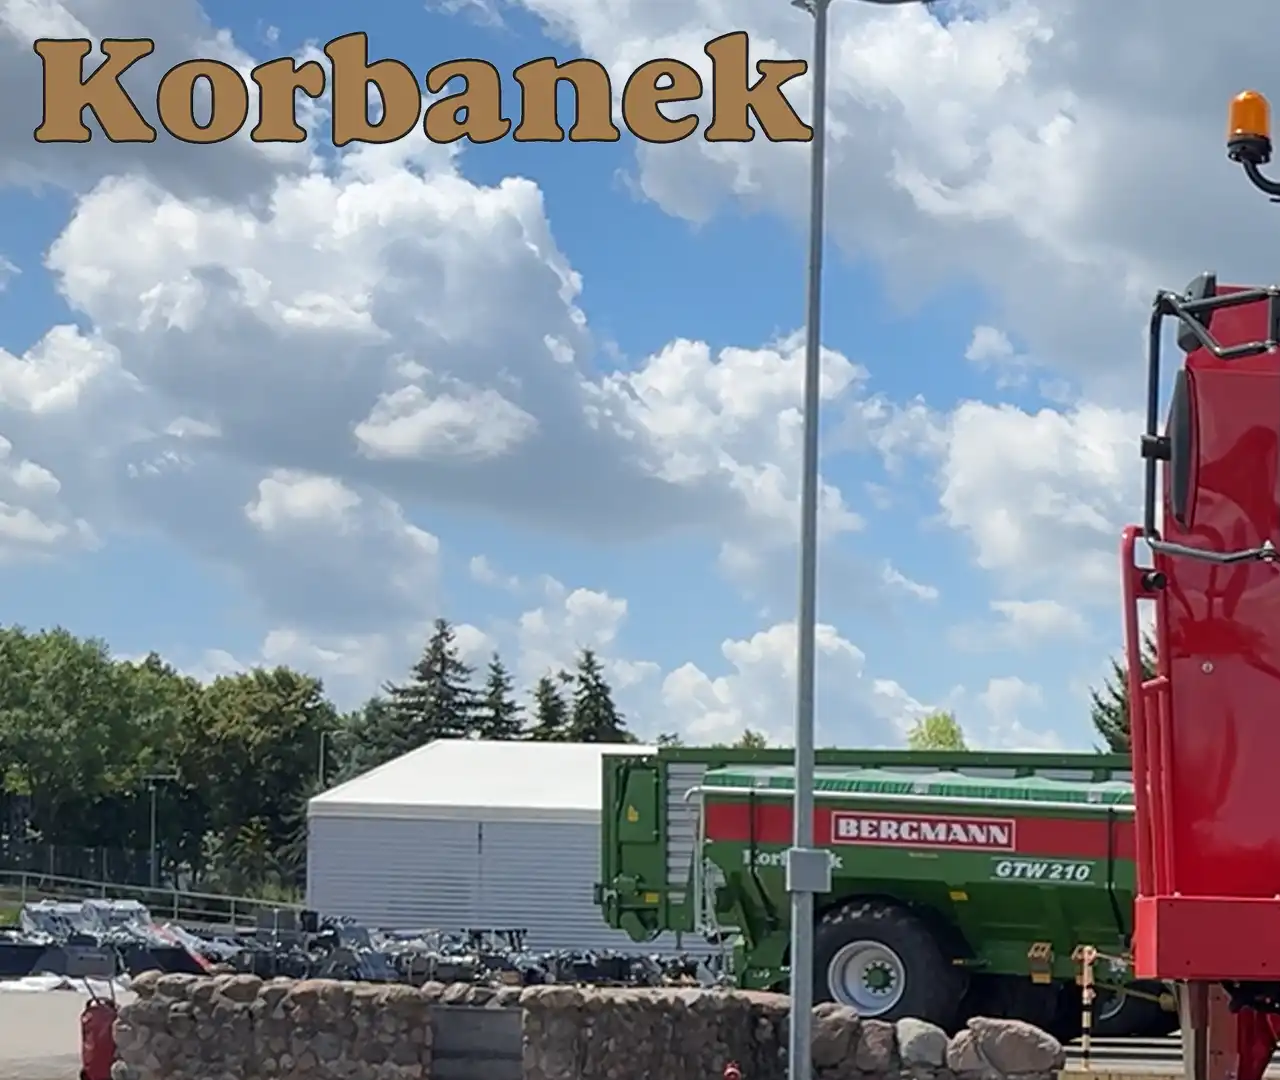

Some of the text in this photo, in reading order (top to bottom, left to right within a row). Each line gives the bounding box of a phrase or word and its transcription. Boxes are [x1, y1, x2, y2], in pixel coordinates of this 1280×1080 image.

[837, 817, 1010, 845] BERGMANN
[995, 860, 1091, 882] GTW 210
